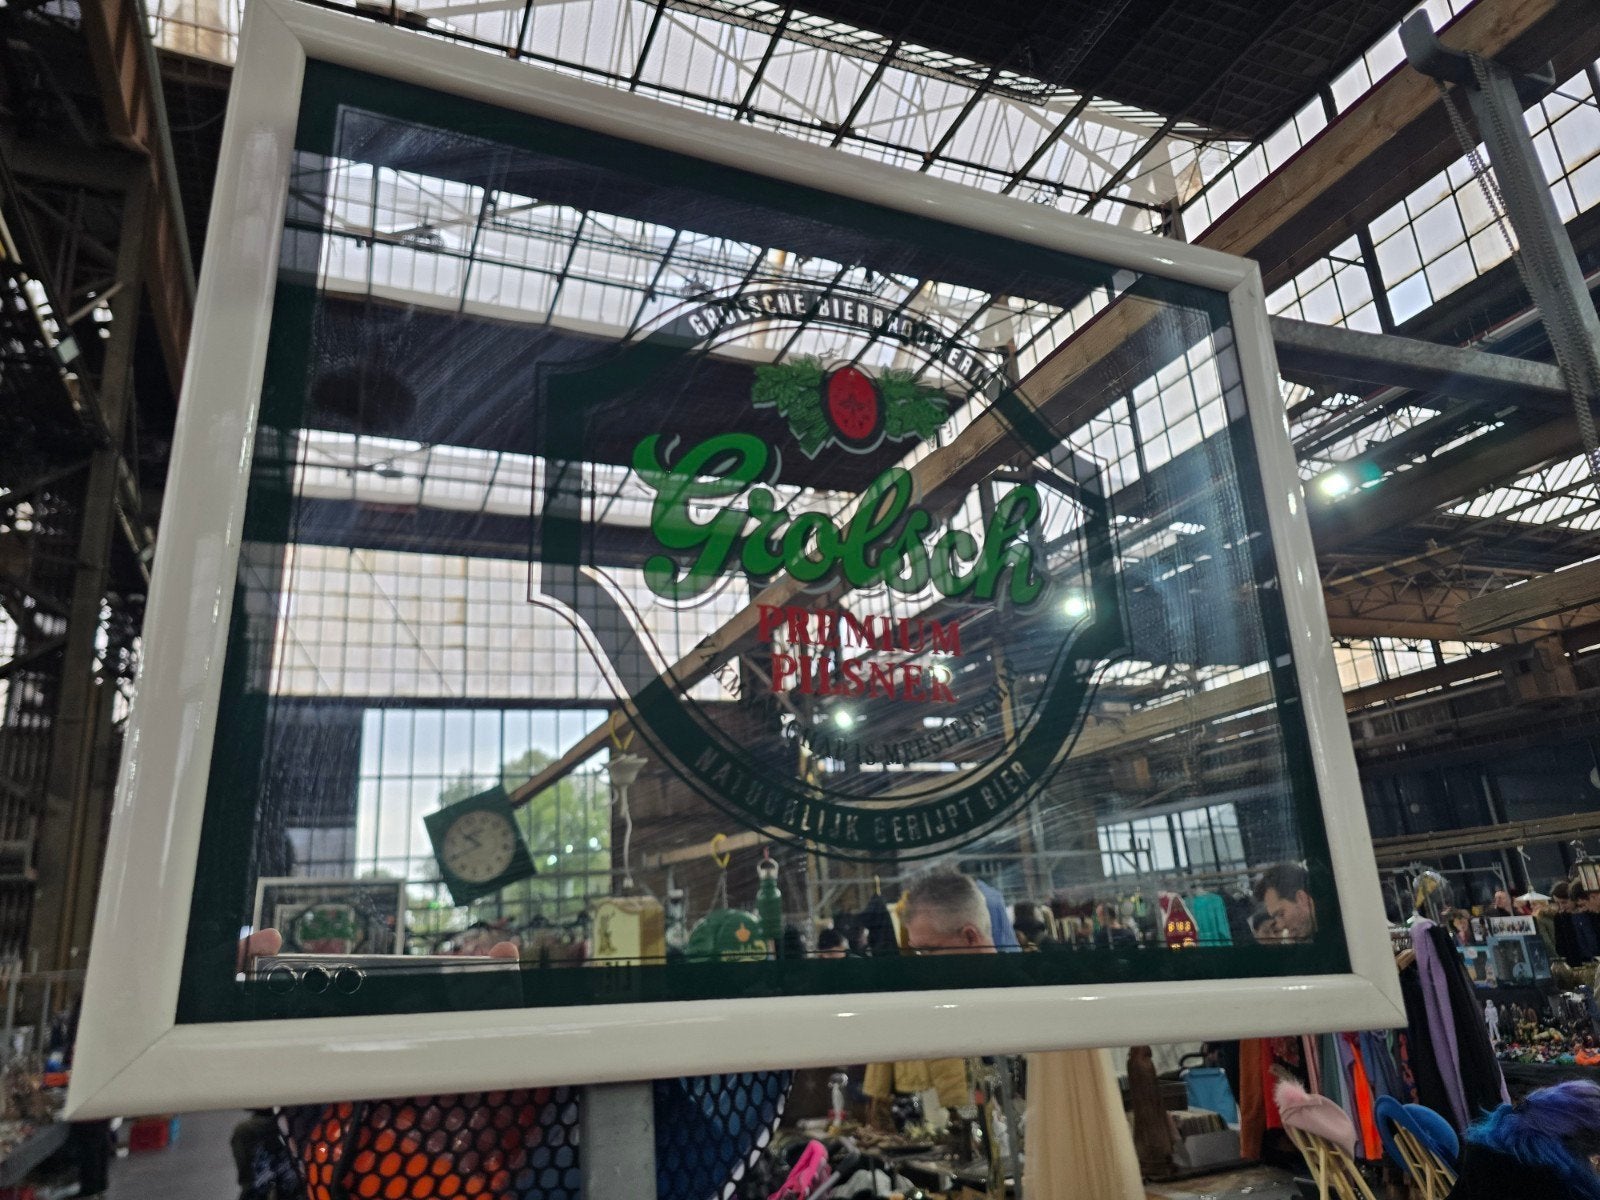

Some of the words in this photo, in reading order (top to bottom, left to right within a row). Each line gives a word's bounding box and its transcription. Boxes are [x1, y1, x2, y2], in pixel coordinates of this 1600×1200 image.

[631, 432, 1046, 603] Grolsch
[757, 604, 962, 657] PREMIUM
[770, 653, 958, 704] PILSNER
[980, 760, 1031, 811] BIER
